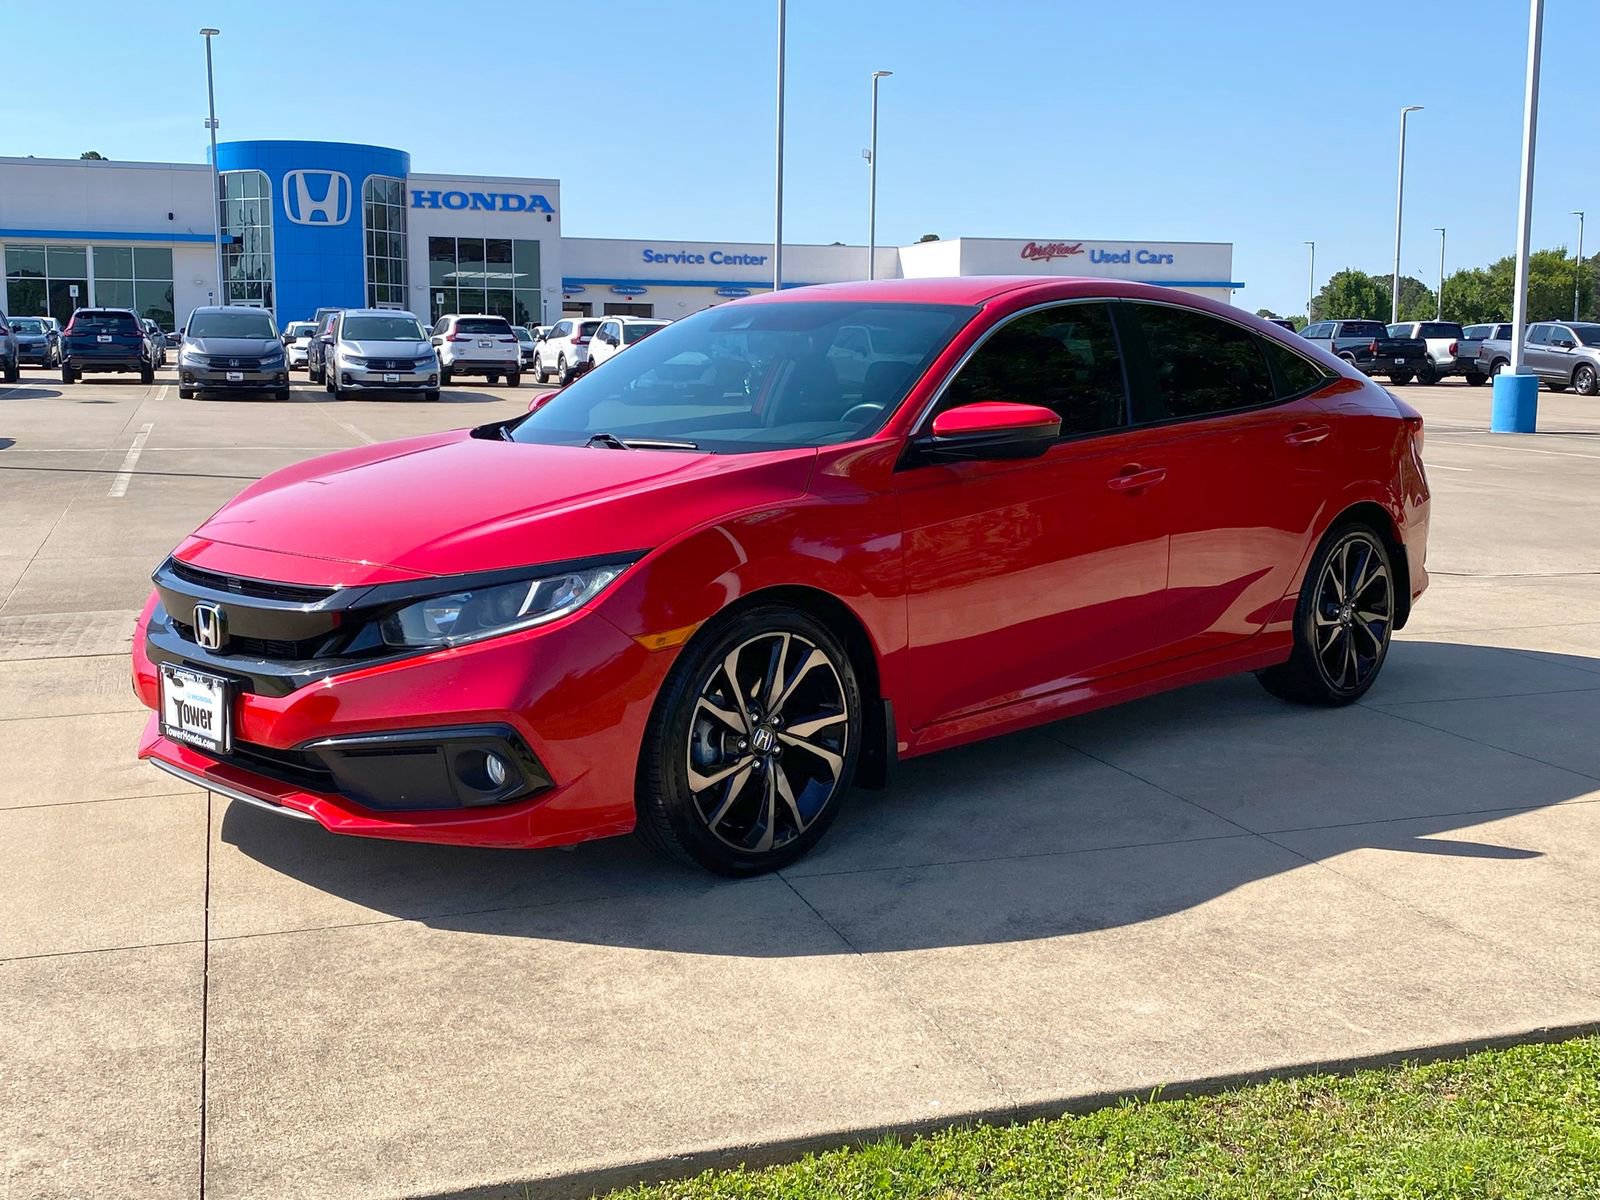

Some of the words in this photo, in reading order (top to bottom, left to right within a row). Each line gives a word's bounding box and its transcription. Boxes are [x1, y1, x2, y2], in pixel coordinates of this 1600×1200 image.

[410, 190, 555, 213] HONDA
[642, 249, 705, 264] Service
[709, 251, 767, 266] Center
[1089, 249, 1131, 264] Used
[1135, 250, 1173, 264] Cars
[172, 696, 213, 731] Tower
[165, 724, 216, 751] TowerHonda.com
